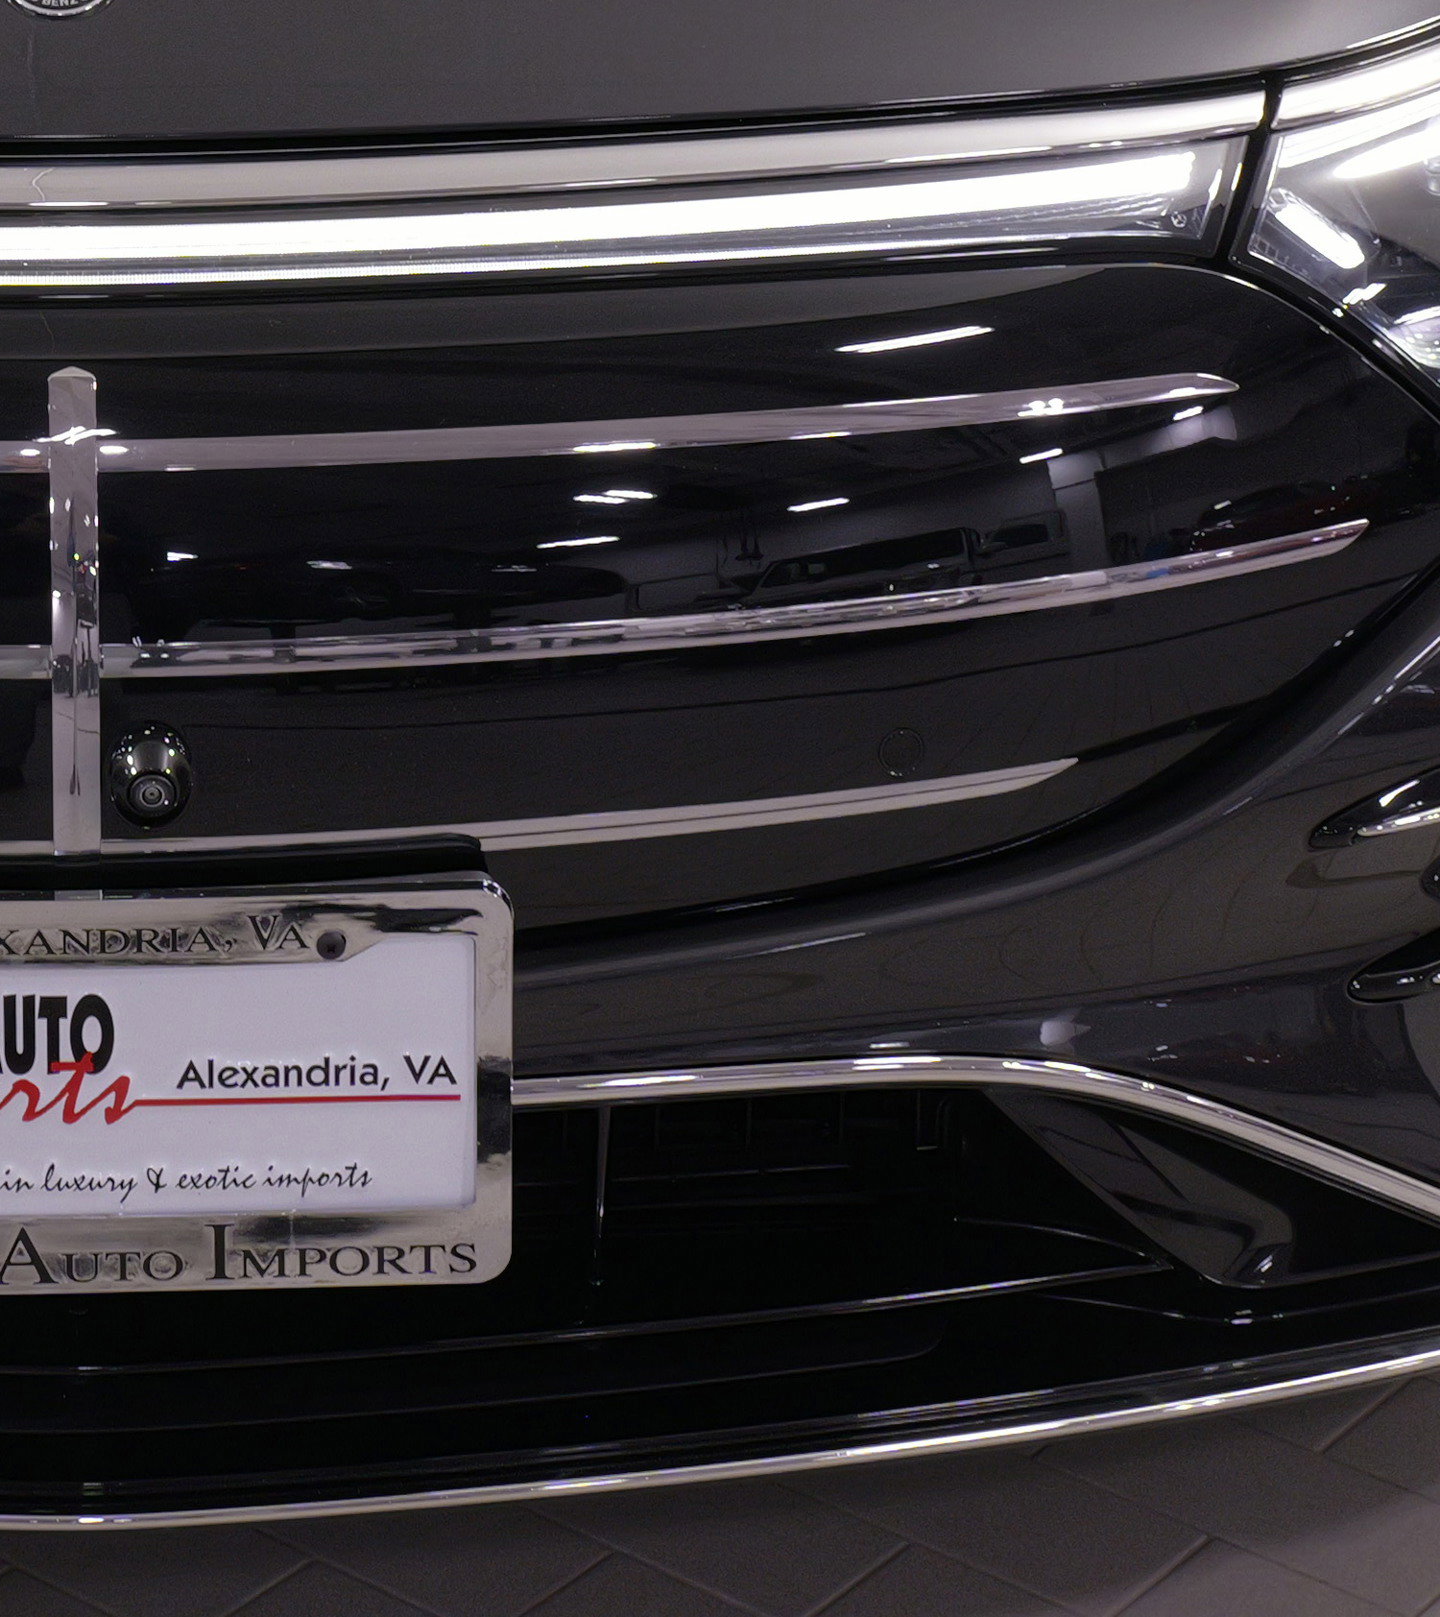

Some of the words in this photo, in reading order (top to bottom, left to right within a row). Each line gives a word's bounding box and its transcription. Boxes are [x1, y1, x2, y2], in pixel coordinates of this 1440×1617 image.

[176, 1055, 390, 1091] Alexandria,
[403, 1055, 458, 1085] VA
[0, 1169, 35, 1193] in
[40, 1164, 137, 1204] luxury
[147, 1168, 166, 1191] &
[175, 1164, 255, 1190] exotic
[262, 1162, 373, 1198] imports
